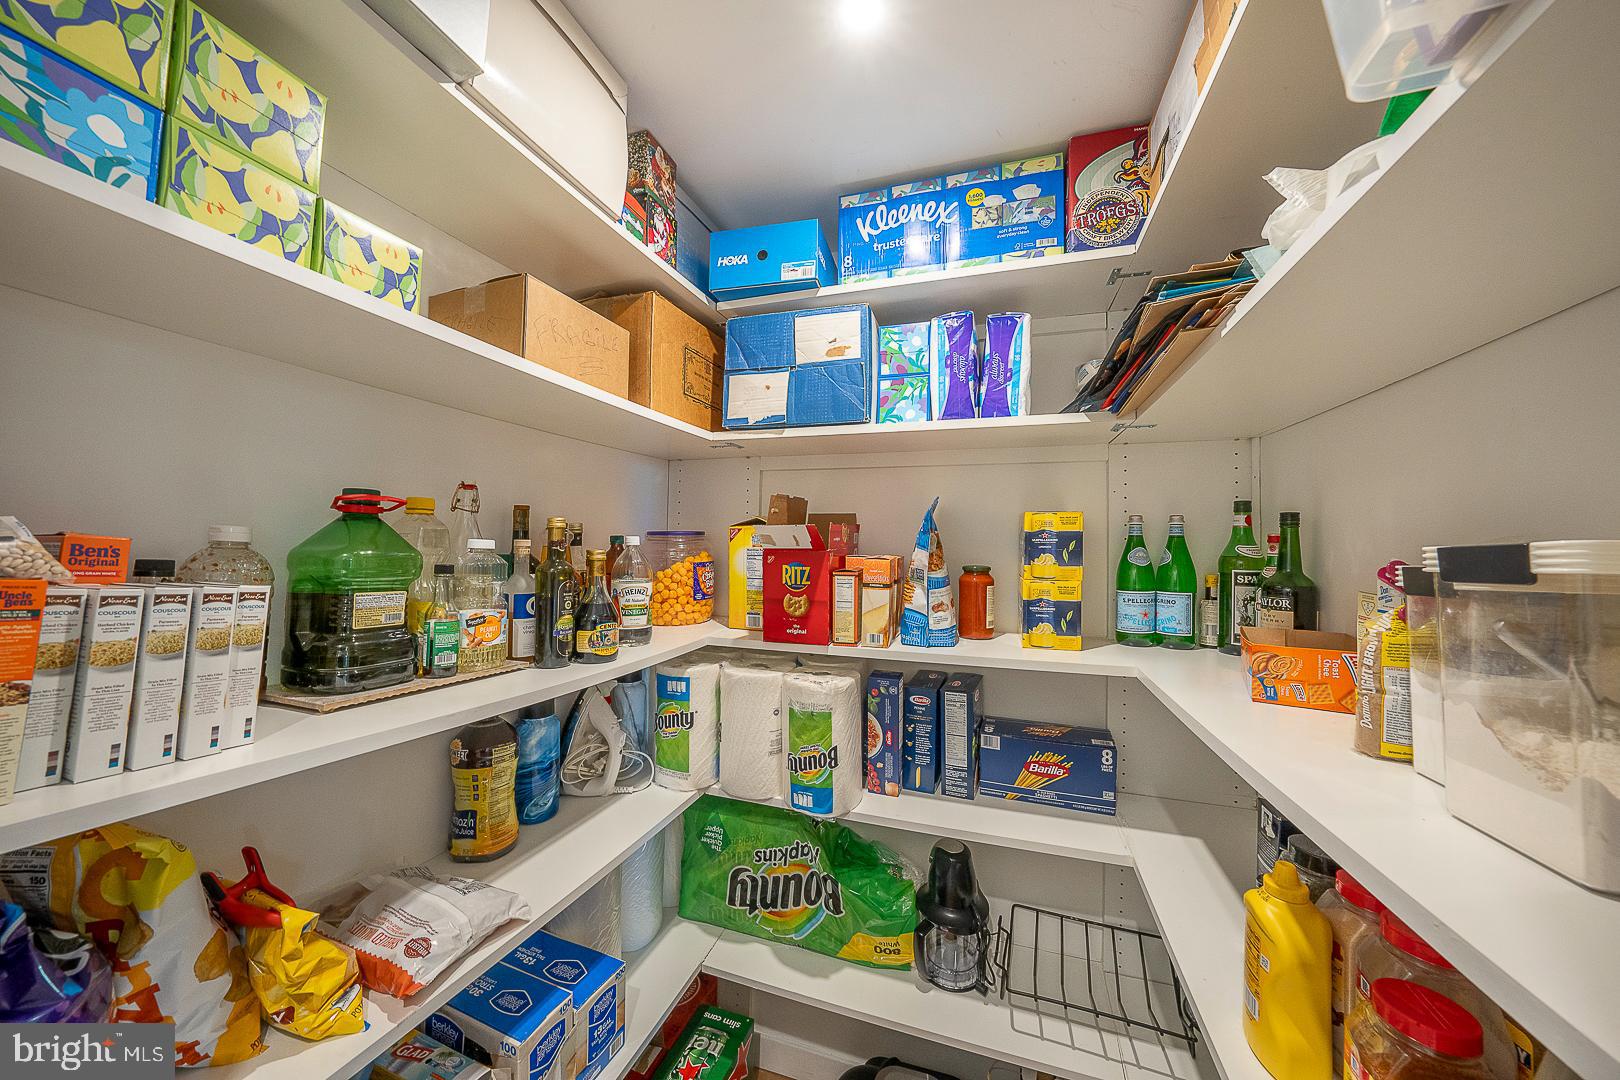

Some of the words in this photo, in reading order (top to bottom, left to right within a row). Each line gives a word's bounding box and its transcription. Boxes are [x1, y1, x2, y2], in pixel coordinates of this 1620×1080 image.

[1082, 190, 1129, 211] INDEPENDENT
[856, 200, 958, 242] Kleenex
[1082, 228, 1102, 240] CRAFT
[1104, 218, 1134, 240] BREWERY
[718, 254, 748, 267] HOKA
[844, 256, 853, 268] 8
[533, 314, 618, 352] FRAGILE
[990, 350, 1000, 380] always
[69, 543, 120, 558] Ben's
[68, 557, 119, 568] Original
[782, 564, 810, 585] RITZ
[1237, 575, 1258, 583] SPA
[625, 588, 646, 596] HEINZ
[122, 596, 136, 604] East
[1260, 598, 1291, 608] AYLOR
[1323, 659, 1331, 677] Chee
[1332, 659, 1341, 678] Toast
[1292, 684, 1305, 700] Lance
[1360, 695, 1373, 729] Domino
[788, 745, 839, 774] Bounty
[1102, 750, 1113, 765] 8
[1029, 763, 1064, 776] Barilla
[704, 831, 723, 840] Picker
[705, 825, 724, 834] Upper
[701, 836, 722, 846] Quicker
[712, 844, 722, 852] The
[754, 842, 820, 867] Napkins
[726, 867, 844, 916] Bounty
[874, 945, 901, 956] 800
[560, 1000, 572, 1015] 100
[704, 1012, 722, 1021] cans
[723, 1018, 741, 1028] slim
[432, 1016, 458, 1040] berkley
[536, 1023, 562, 1055] berkley
[396, 1044, 430, 1058] GLAD
[500, 1041, 517, 1056] 100
